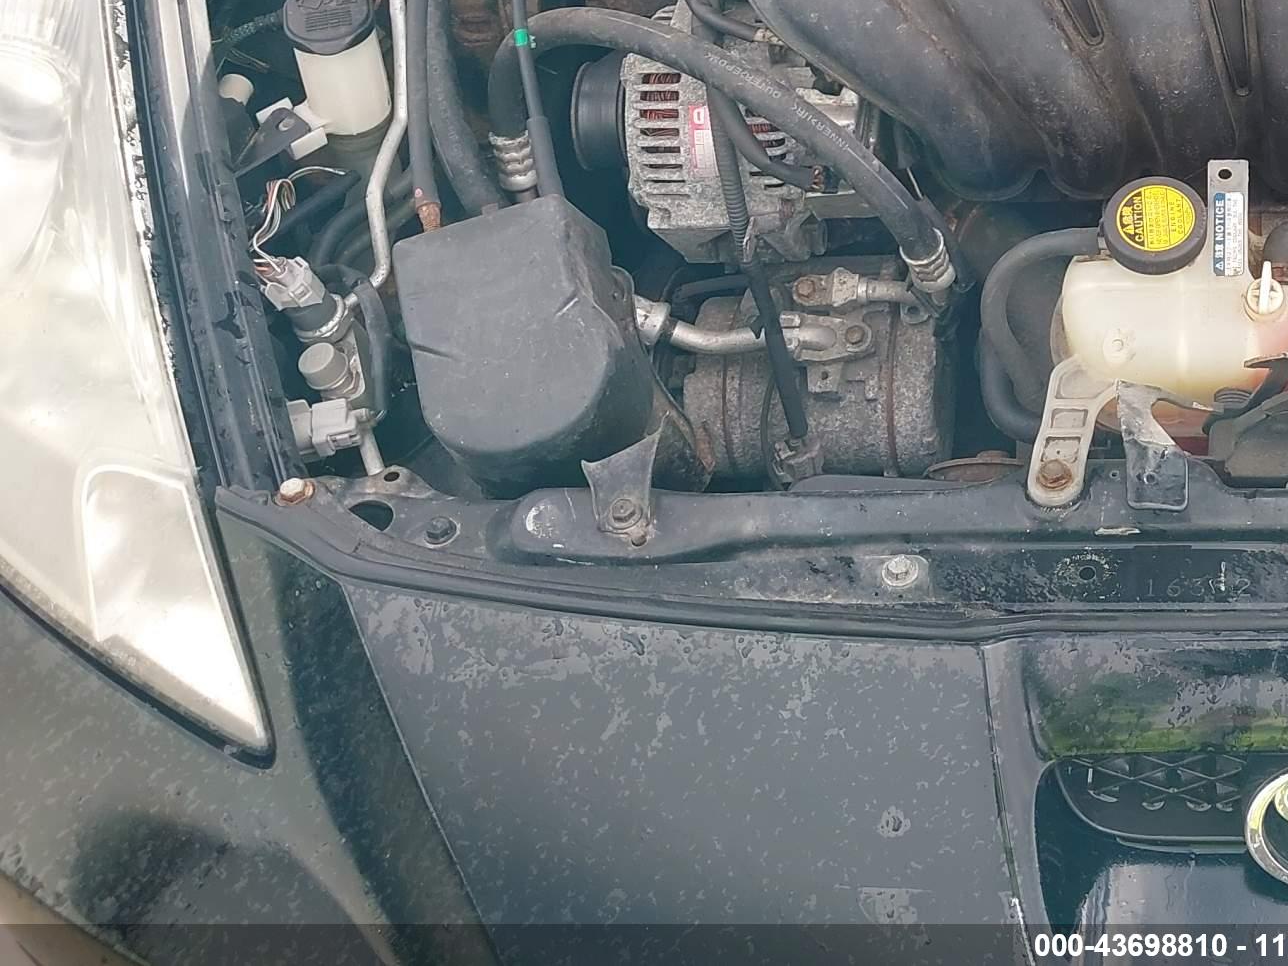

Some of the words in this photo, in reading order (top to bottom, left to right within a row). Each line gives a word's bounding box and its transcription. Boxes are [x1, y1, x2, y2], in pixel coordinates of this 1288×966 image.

[1133, 196, 1144, 243] CAUTION
[1169, 200, 1178, 233] ENGINE
[1175, 198, 1184, 235] COOLANT
[1215, 199, 1225, 241] NOTICE
